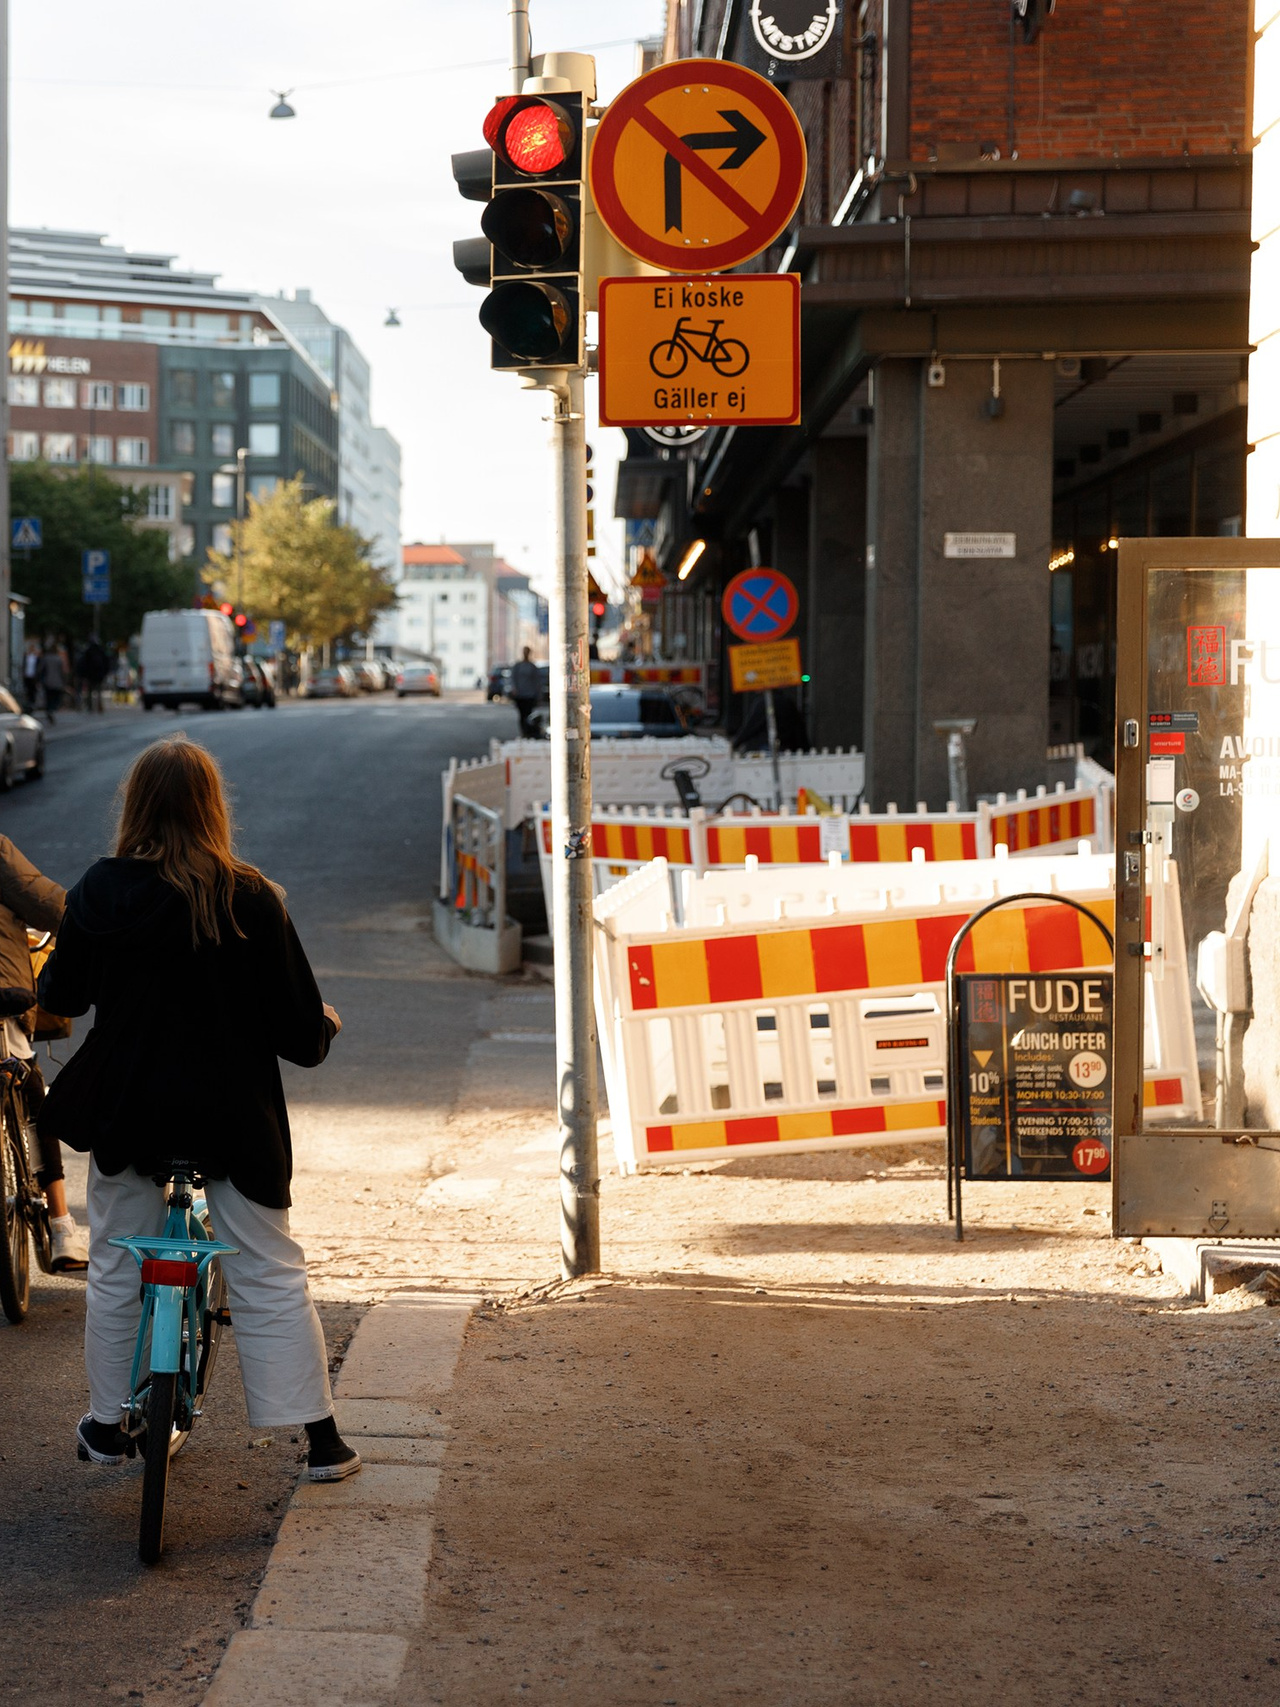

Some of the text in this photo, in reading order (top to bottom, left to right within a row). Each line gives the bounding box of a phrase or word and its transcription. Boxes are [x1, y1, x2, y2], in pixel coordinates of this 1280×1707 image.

[760, 15, 828, 51] MESTARI
[654, 286, 744, 308] Ei koske
[654, 386, 746, 413] Gäller ej
[1220, 735, 1280, 759] AVOI
[1008, 979, 1104, 1013] FUDE
[1049, 1013, 1104, 1022] RESTAURANT
[1012, 1032, 1106, 1050] LUNCH OFFER
[969, 1071, 1000, 1094] 10%
[970, 1096, 1001, 1106] Discount
[1016, 1091, 1054, 1100] MON-FRI
[970, 1106, 980, 1115] for
[970, 1116, 1001, 1126] Students
[1017, 1117, 1107, 1126] EVENING 17:00-21:00
[1018, 1127, 1064, 1136] WEEKENDS
